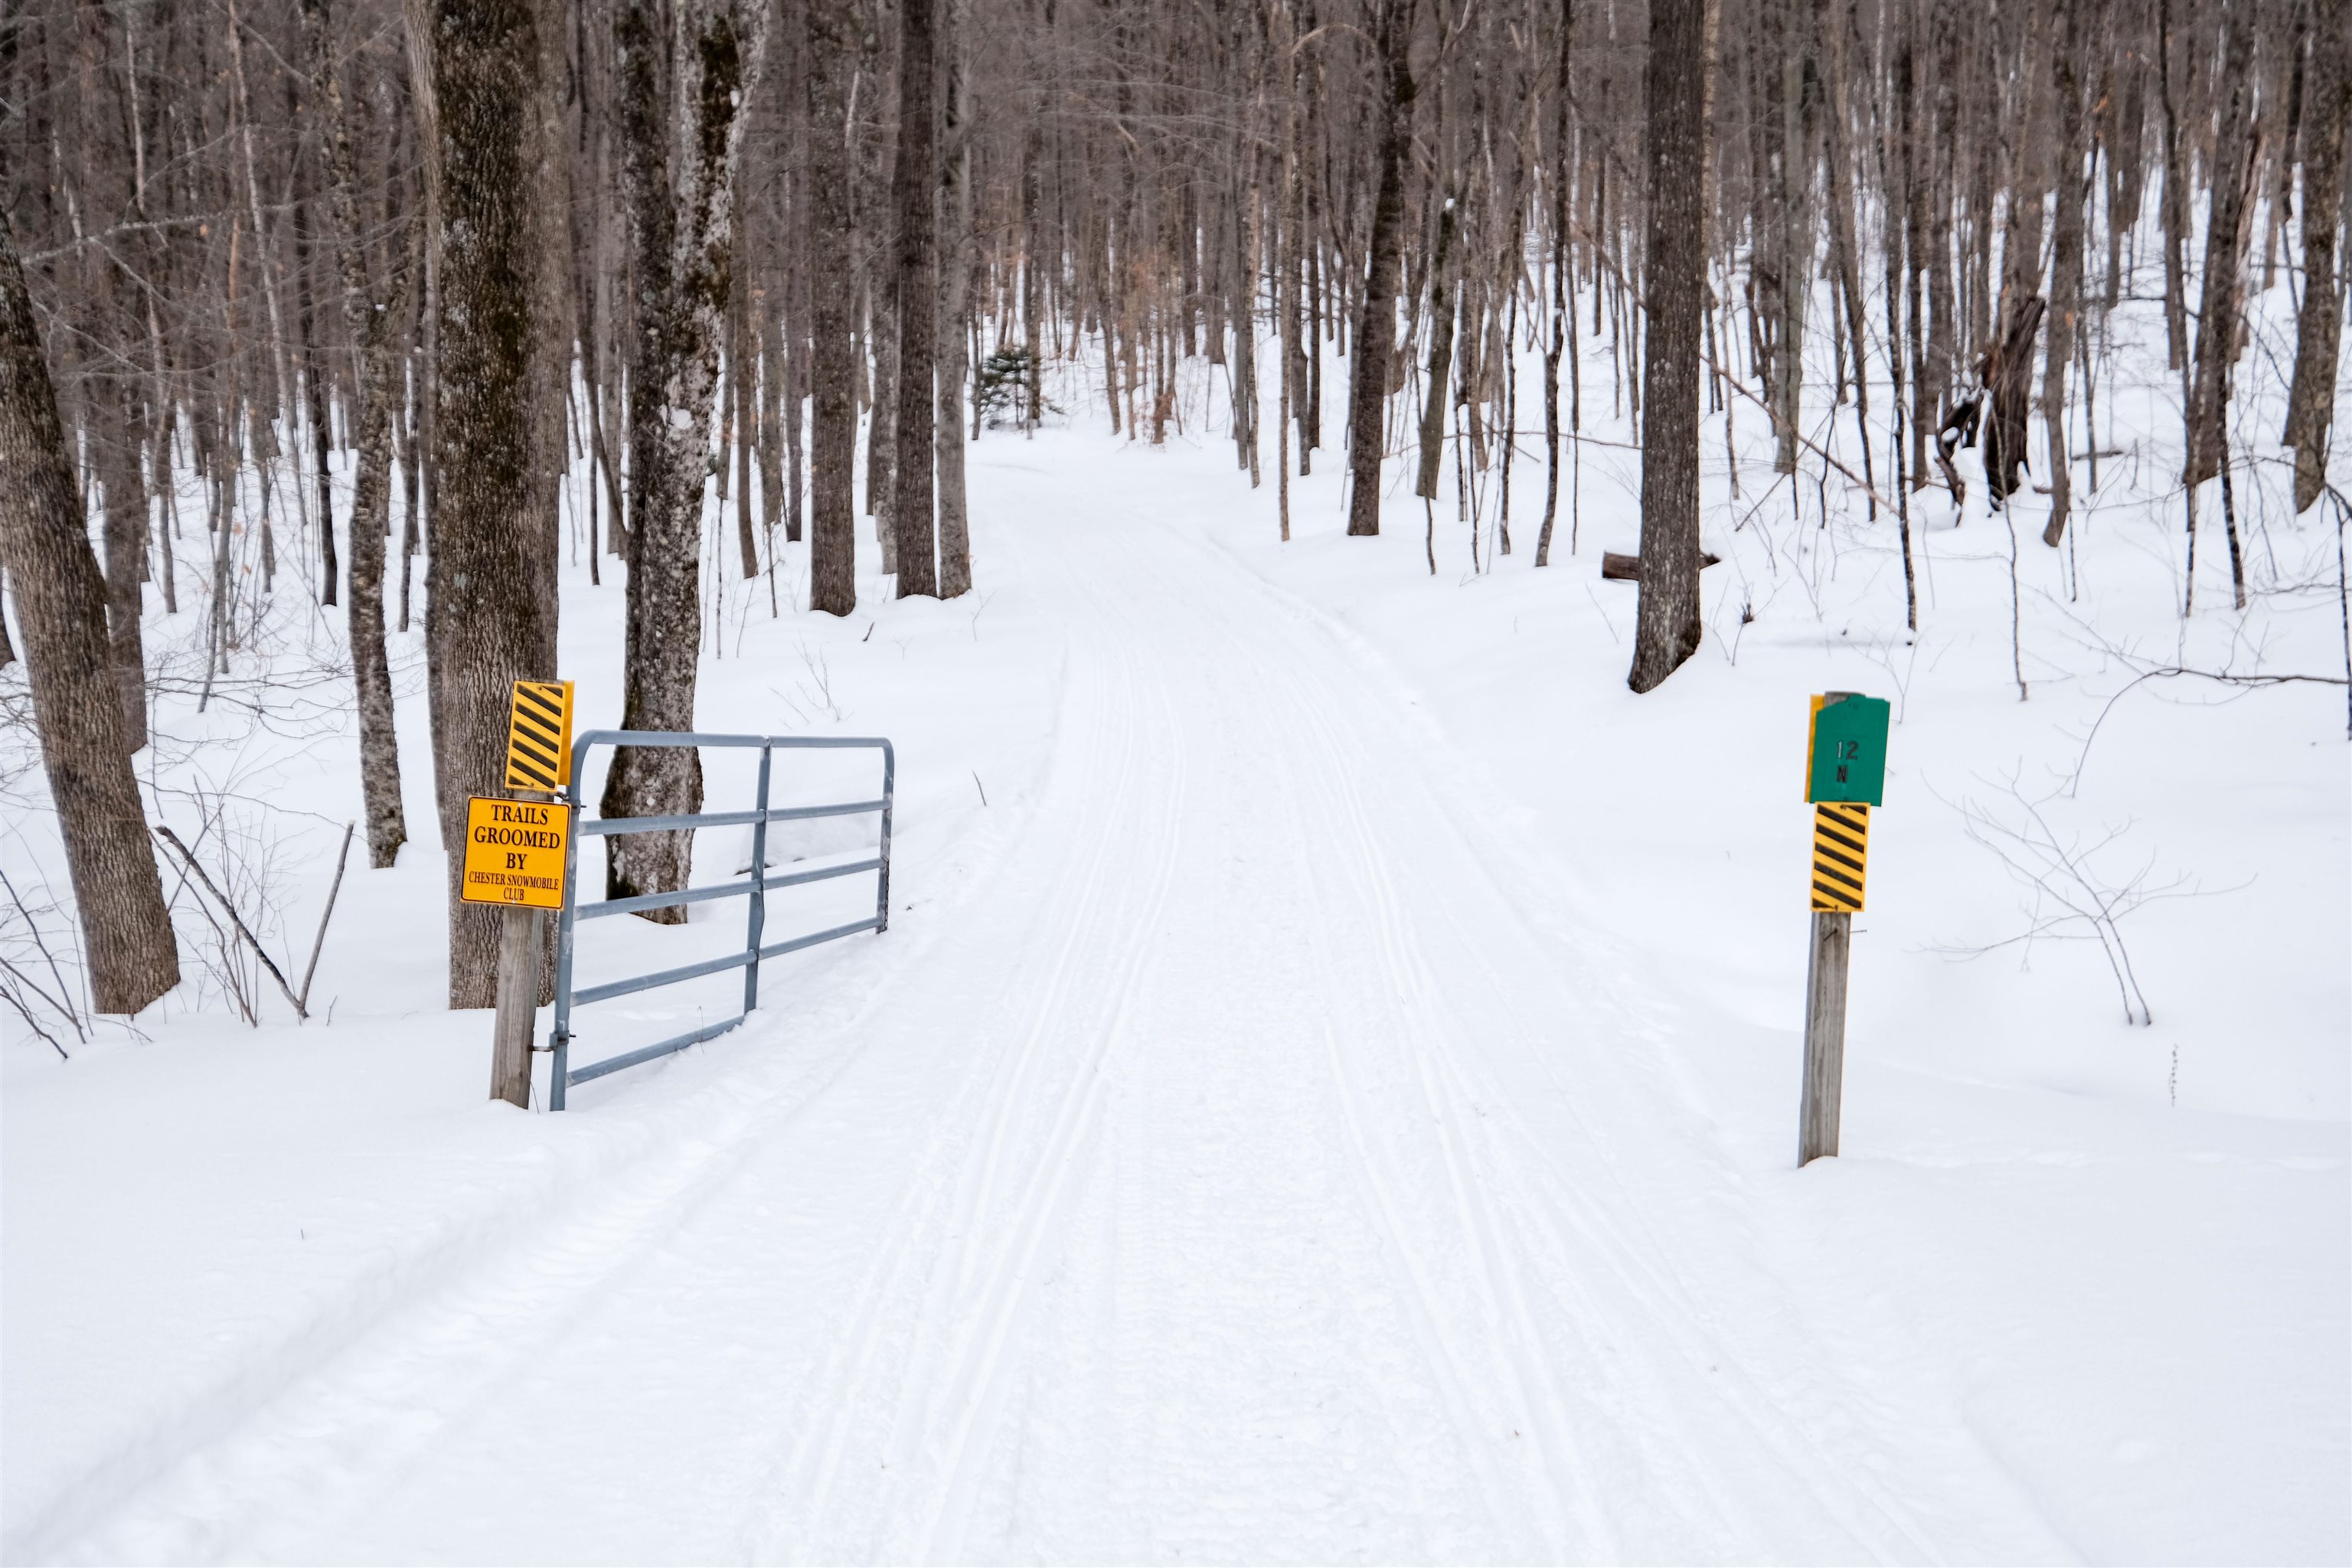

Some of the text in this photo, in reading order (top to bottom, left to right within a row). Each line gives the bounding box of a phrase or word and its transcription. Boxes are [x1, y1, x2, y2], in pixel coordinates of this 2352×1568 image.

[1836, 740, 1858, 760] 12
[1837, 765, 1847, 783] N
[491, 804, 548, 825] TRAILS
[474, 825, 560, 849] GROOMED
[505, 852, 528, 870] BY
[469, 871, 559, 890] CHESTER SNOWMOBILE
[503, 887, 524, 900] CLUB
